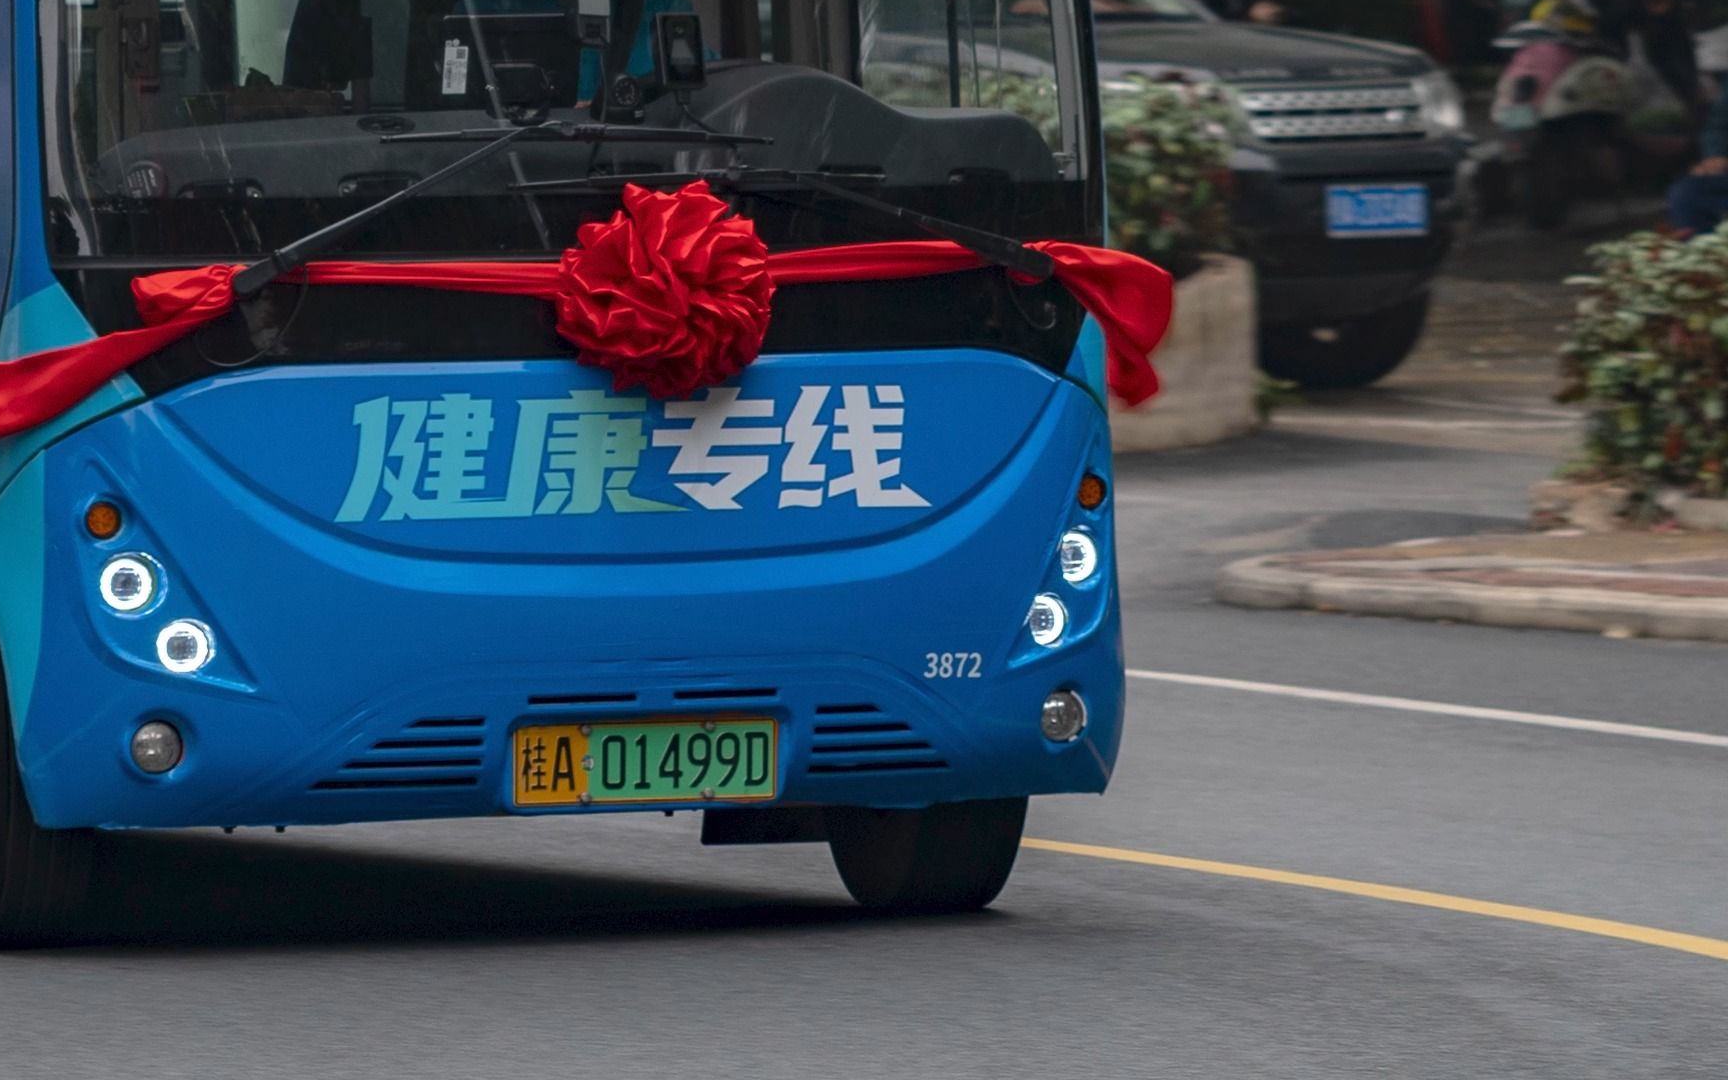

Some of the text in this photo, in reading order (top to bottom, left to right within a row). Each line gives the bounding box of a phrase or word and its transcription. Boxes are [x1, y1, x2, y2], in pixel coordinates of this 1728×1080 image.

[334, 385, 932, 522] 健康专线
[923, 652, 982, 679] 3872
[522, 731, 769, 792] 桂A 01499D
